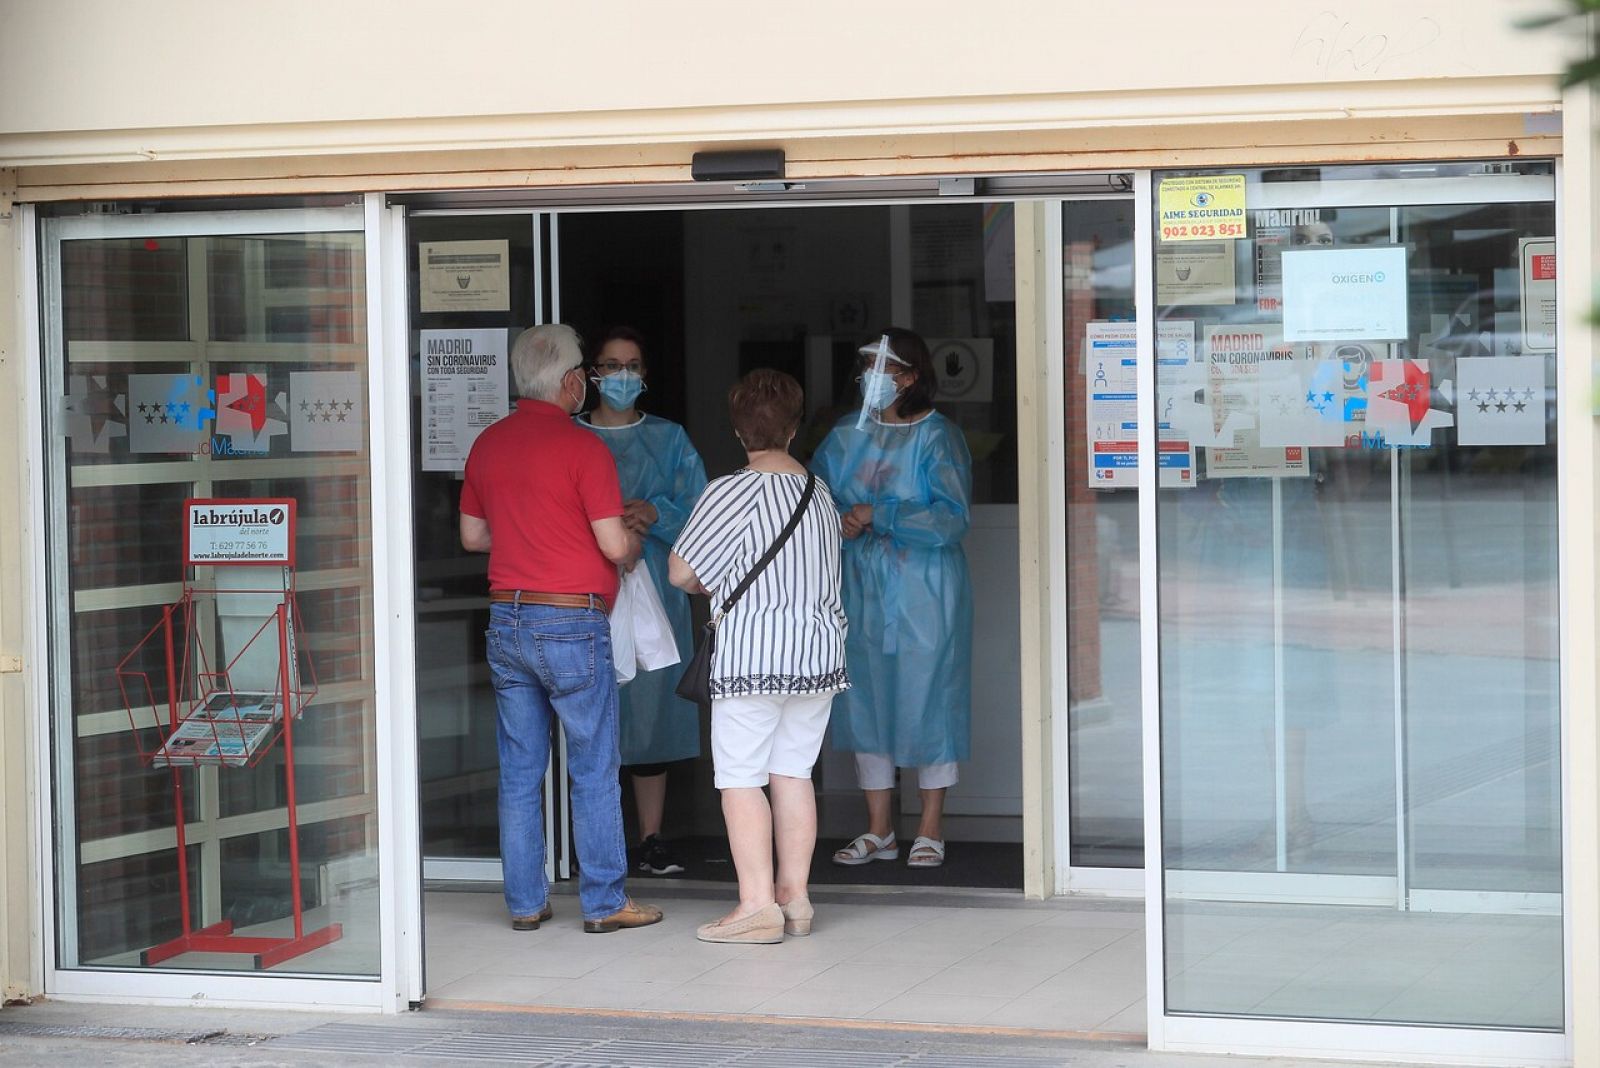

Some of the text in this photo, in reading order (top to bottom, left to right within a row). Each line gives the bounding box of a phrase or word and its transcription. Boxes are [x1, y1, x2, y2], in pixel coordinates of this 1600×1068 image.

[1163, 208, 1243, 220] AIME SEGURIDAD
[1163, 223, 1242, 238] 902 023 851
[427, 339, 472, 355] MADRID
[1211, 334, 1264, 352] MADRID
[427, 354, 497, 366] SIN CORONAVIRUS
[1211, 350, 1294, 364] SIN CORONAVIRUS
[440, 366, 456, 374] TODA
[456, 366, 488, 374] SEGURIDAD
[218, 541, 234, 550] 629
[235, 541, 246, 550] 77
[247, 541, 256, 550] 56
[258, 541, 268, 550] 76
[193, 551, 284, 560] www.labrujuladelnorte.com
